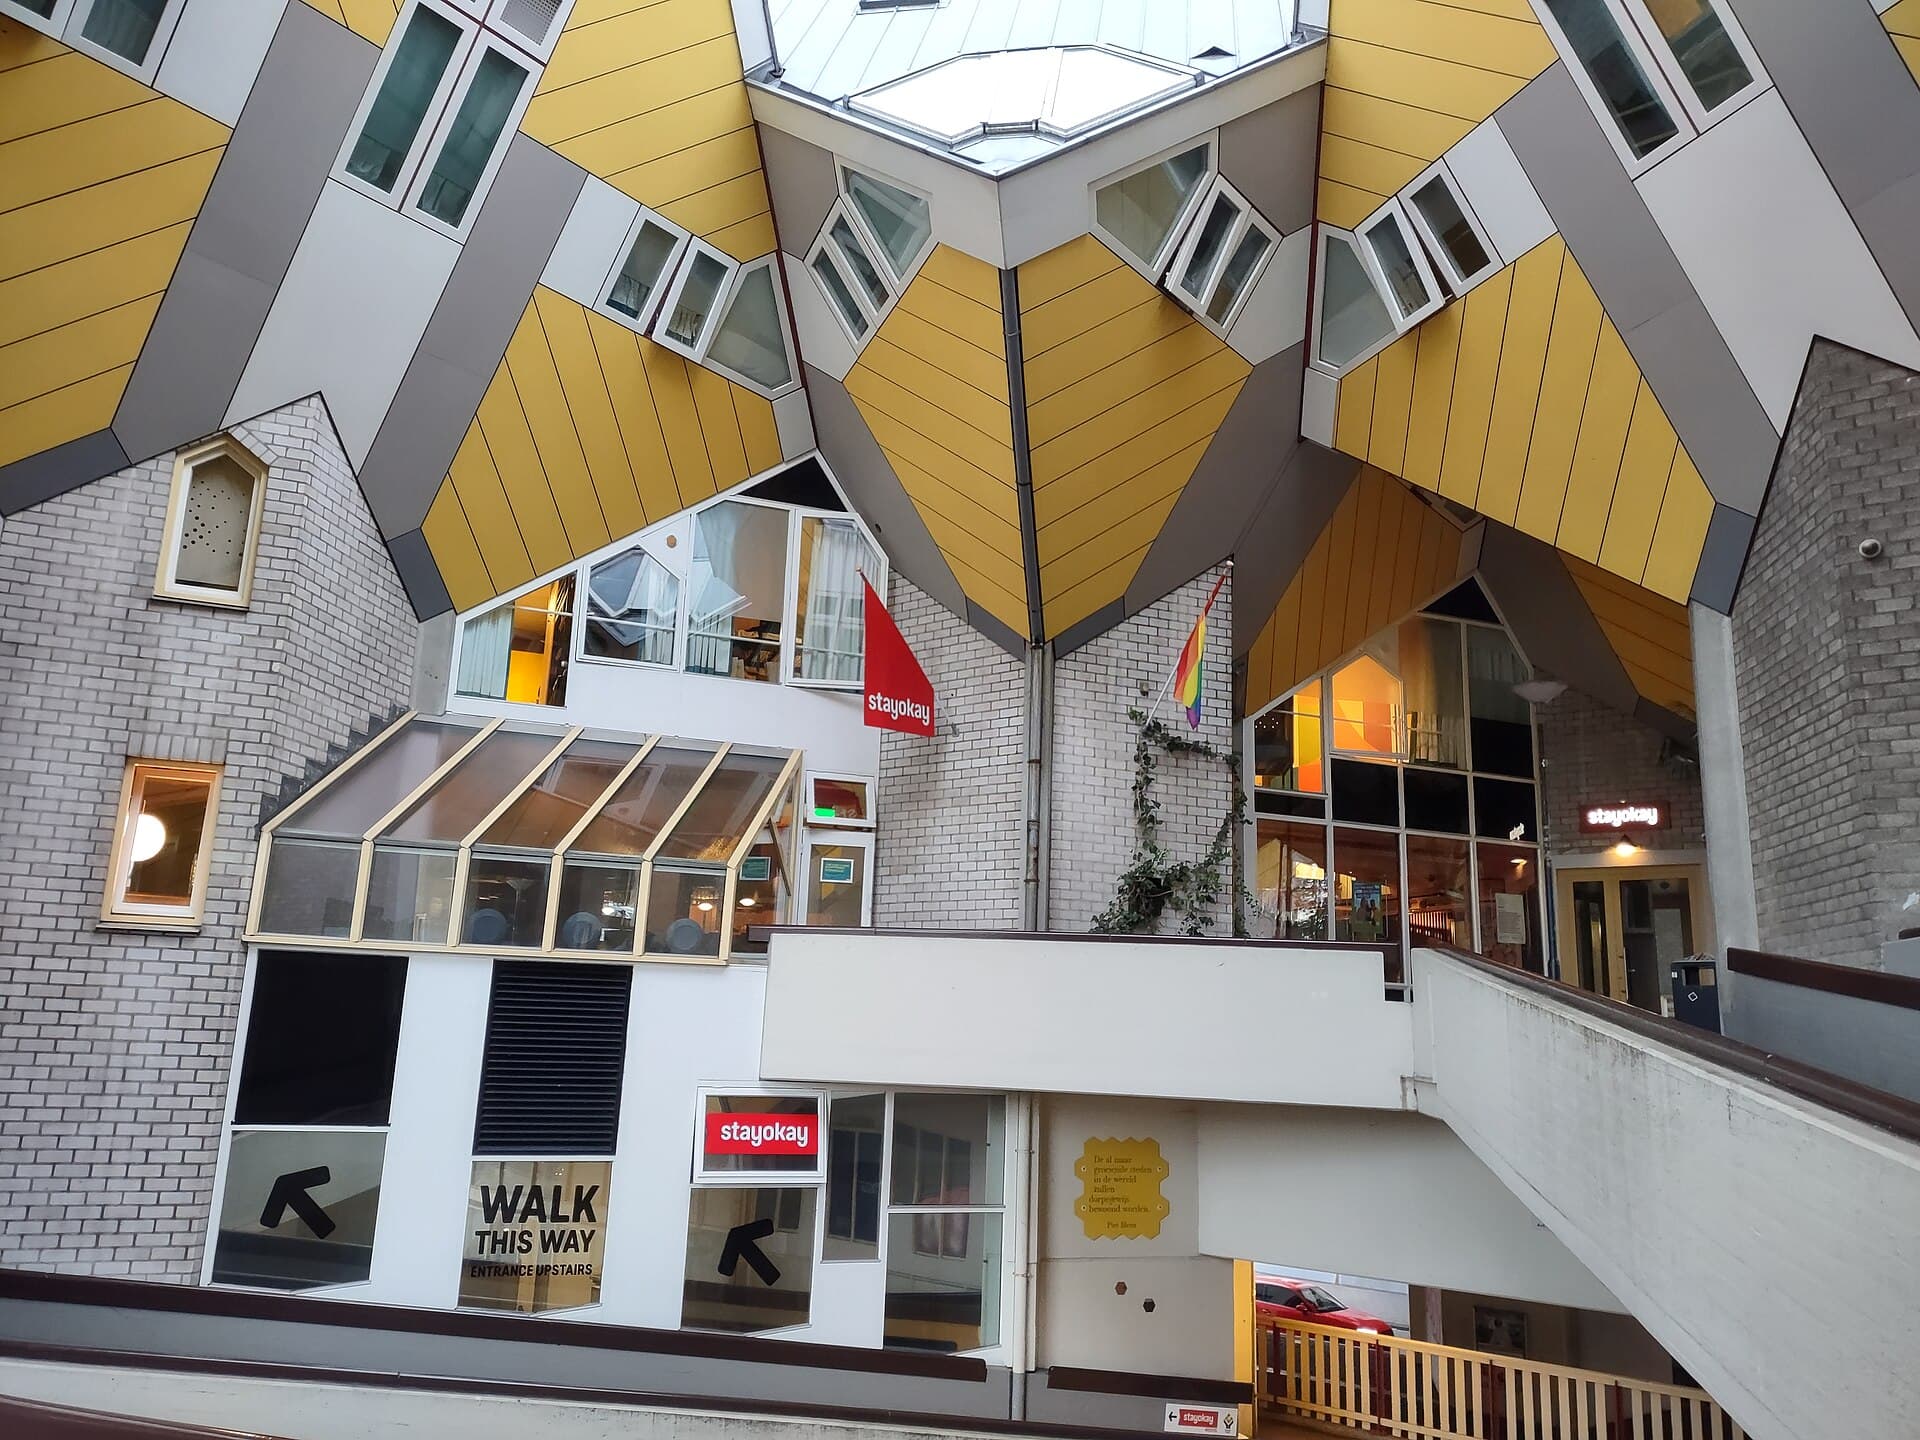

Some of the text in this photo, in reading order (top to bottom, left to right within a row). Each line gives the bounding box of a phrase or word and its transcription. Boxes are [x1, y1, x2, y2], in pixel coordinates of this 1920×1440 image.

[868, 692, 930, 726] stayokay
[1587, 807, 1658, 827] stayokay
[720, 1121, 808, 1148] stayokay
[480, 1185, 600, 1224] WALK
[475, 1229, 596, 1255] THIS WAY
[470, 1263, 593, 1278] ENTRANCE UPSTAIRS
[1183, 1412, 1214, 1425] stayokay
